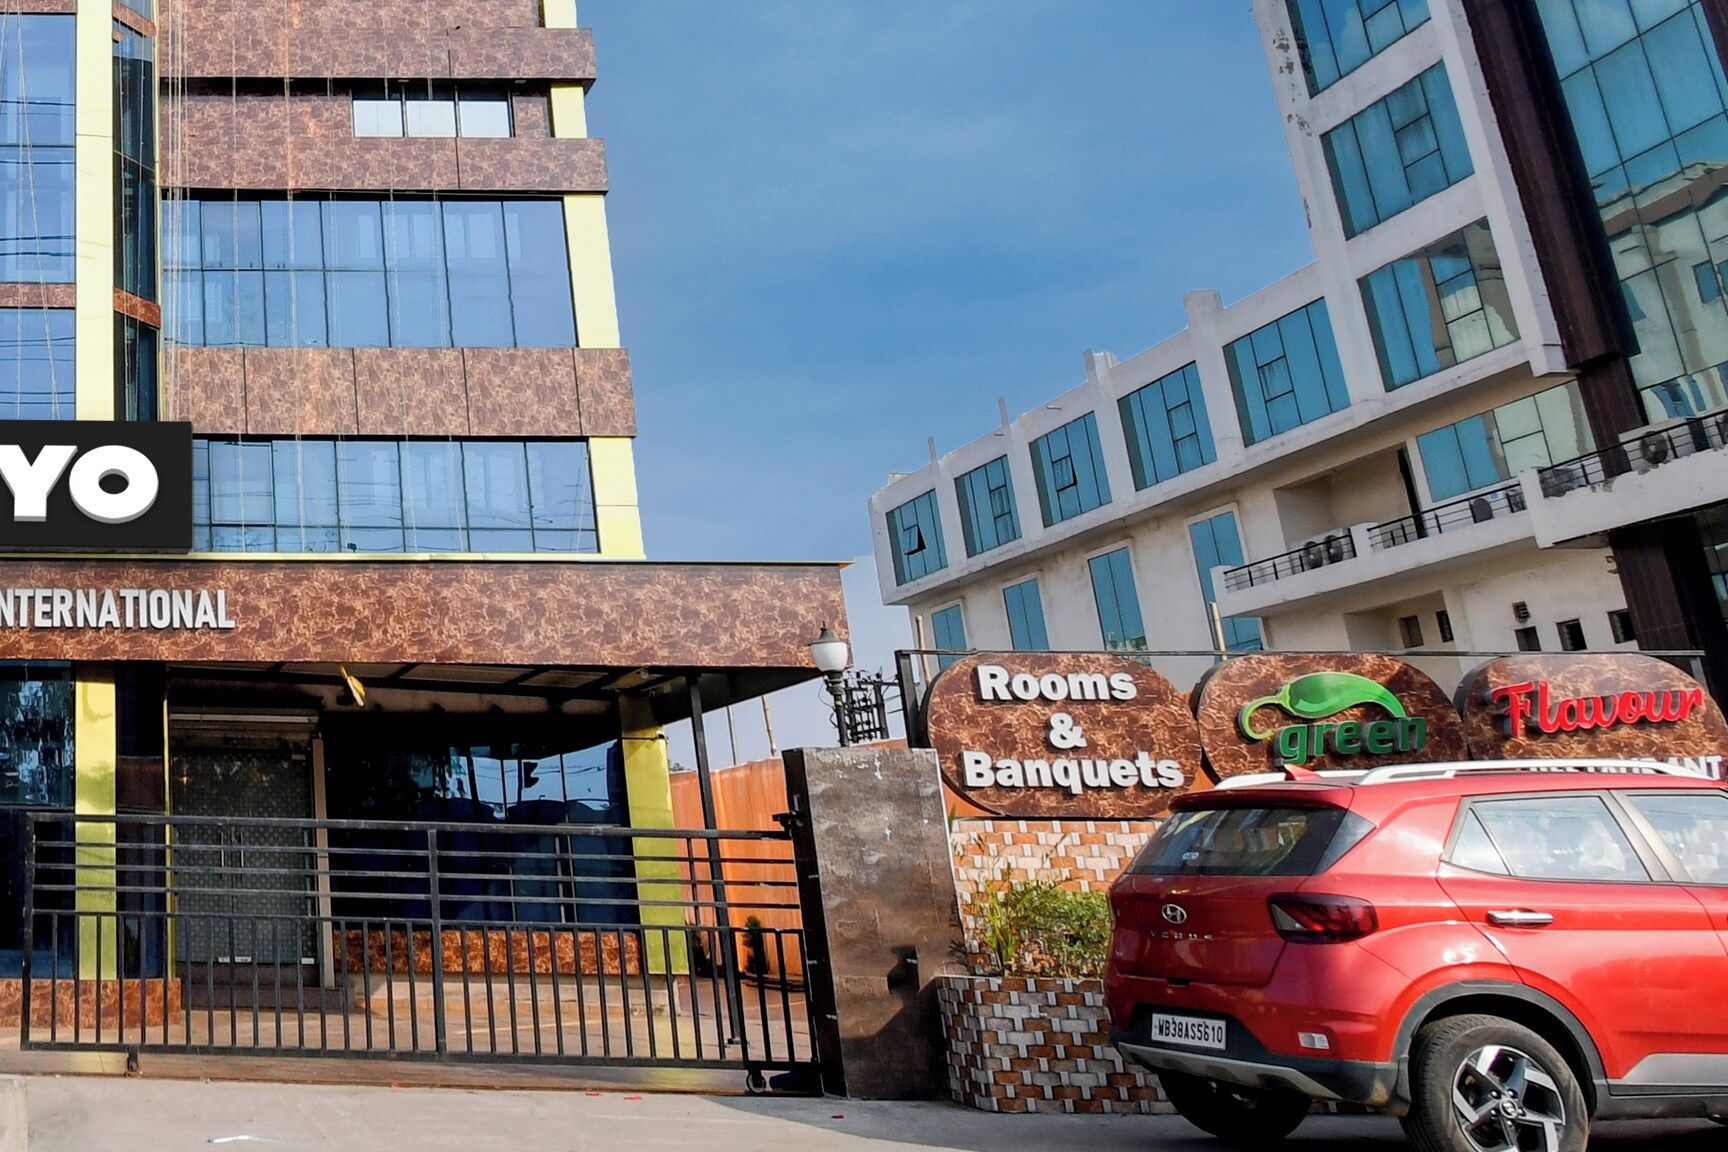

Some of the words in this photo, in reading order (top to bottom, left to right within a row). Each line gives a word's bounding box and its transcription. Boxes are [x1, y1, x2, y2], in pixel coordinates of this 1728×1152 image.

[976, 664, 1138, 701] Rooms
[1491, 680, 1703, 738] Flavour
[1048, 712, 1087, 749] &
[1274, 716, 1426, 765] green
[962, 751, 1185, 795] Banquets
[1157, 1018, 1223, 1044] WB38AS5610
